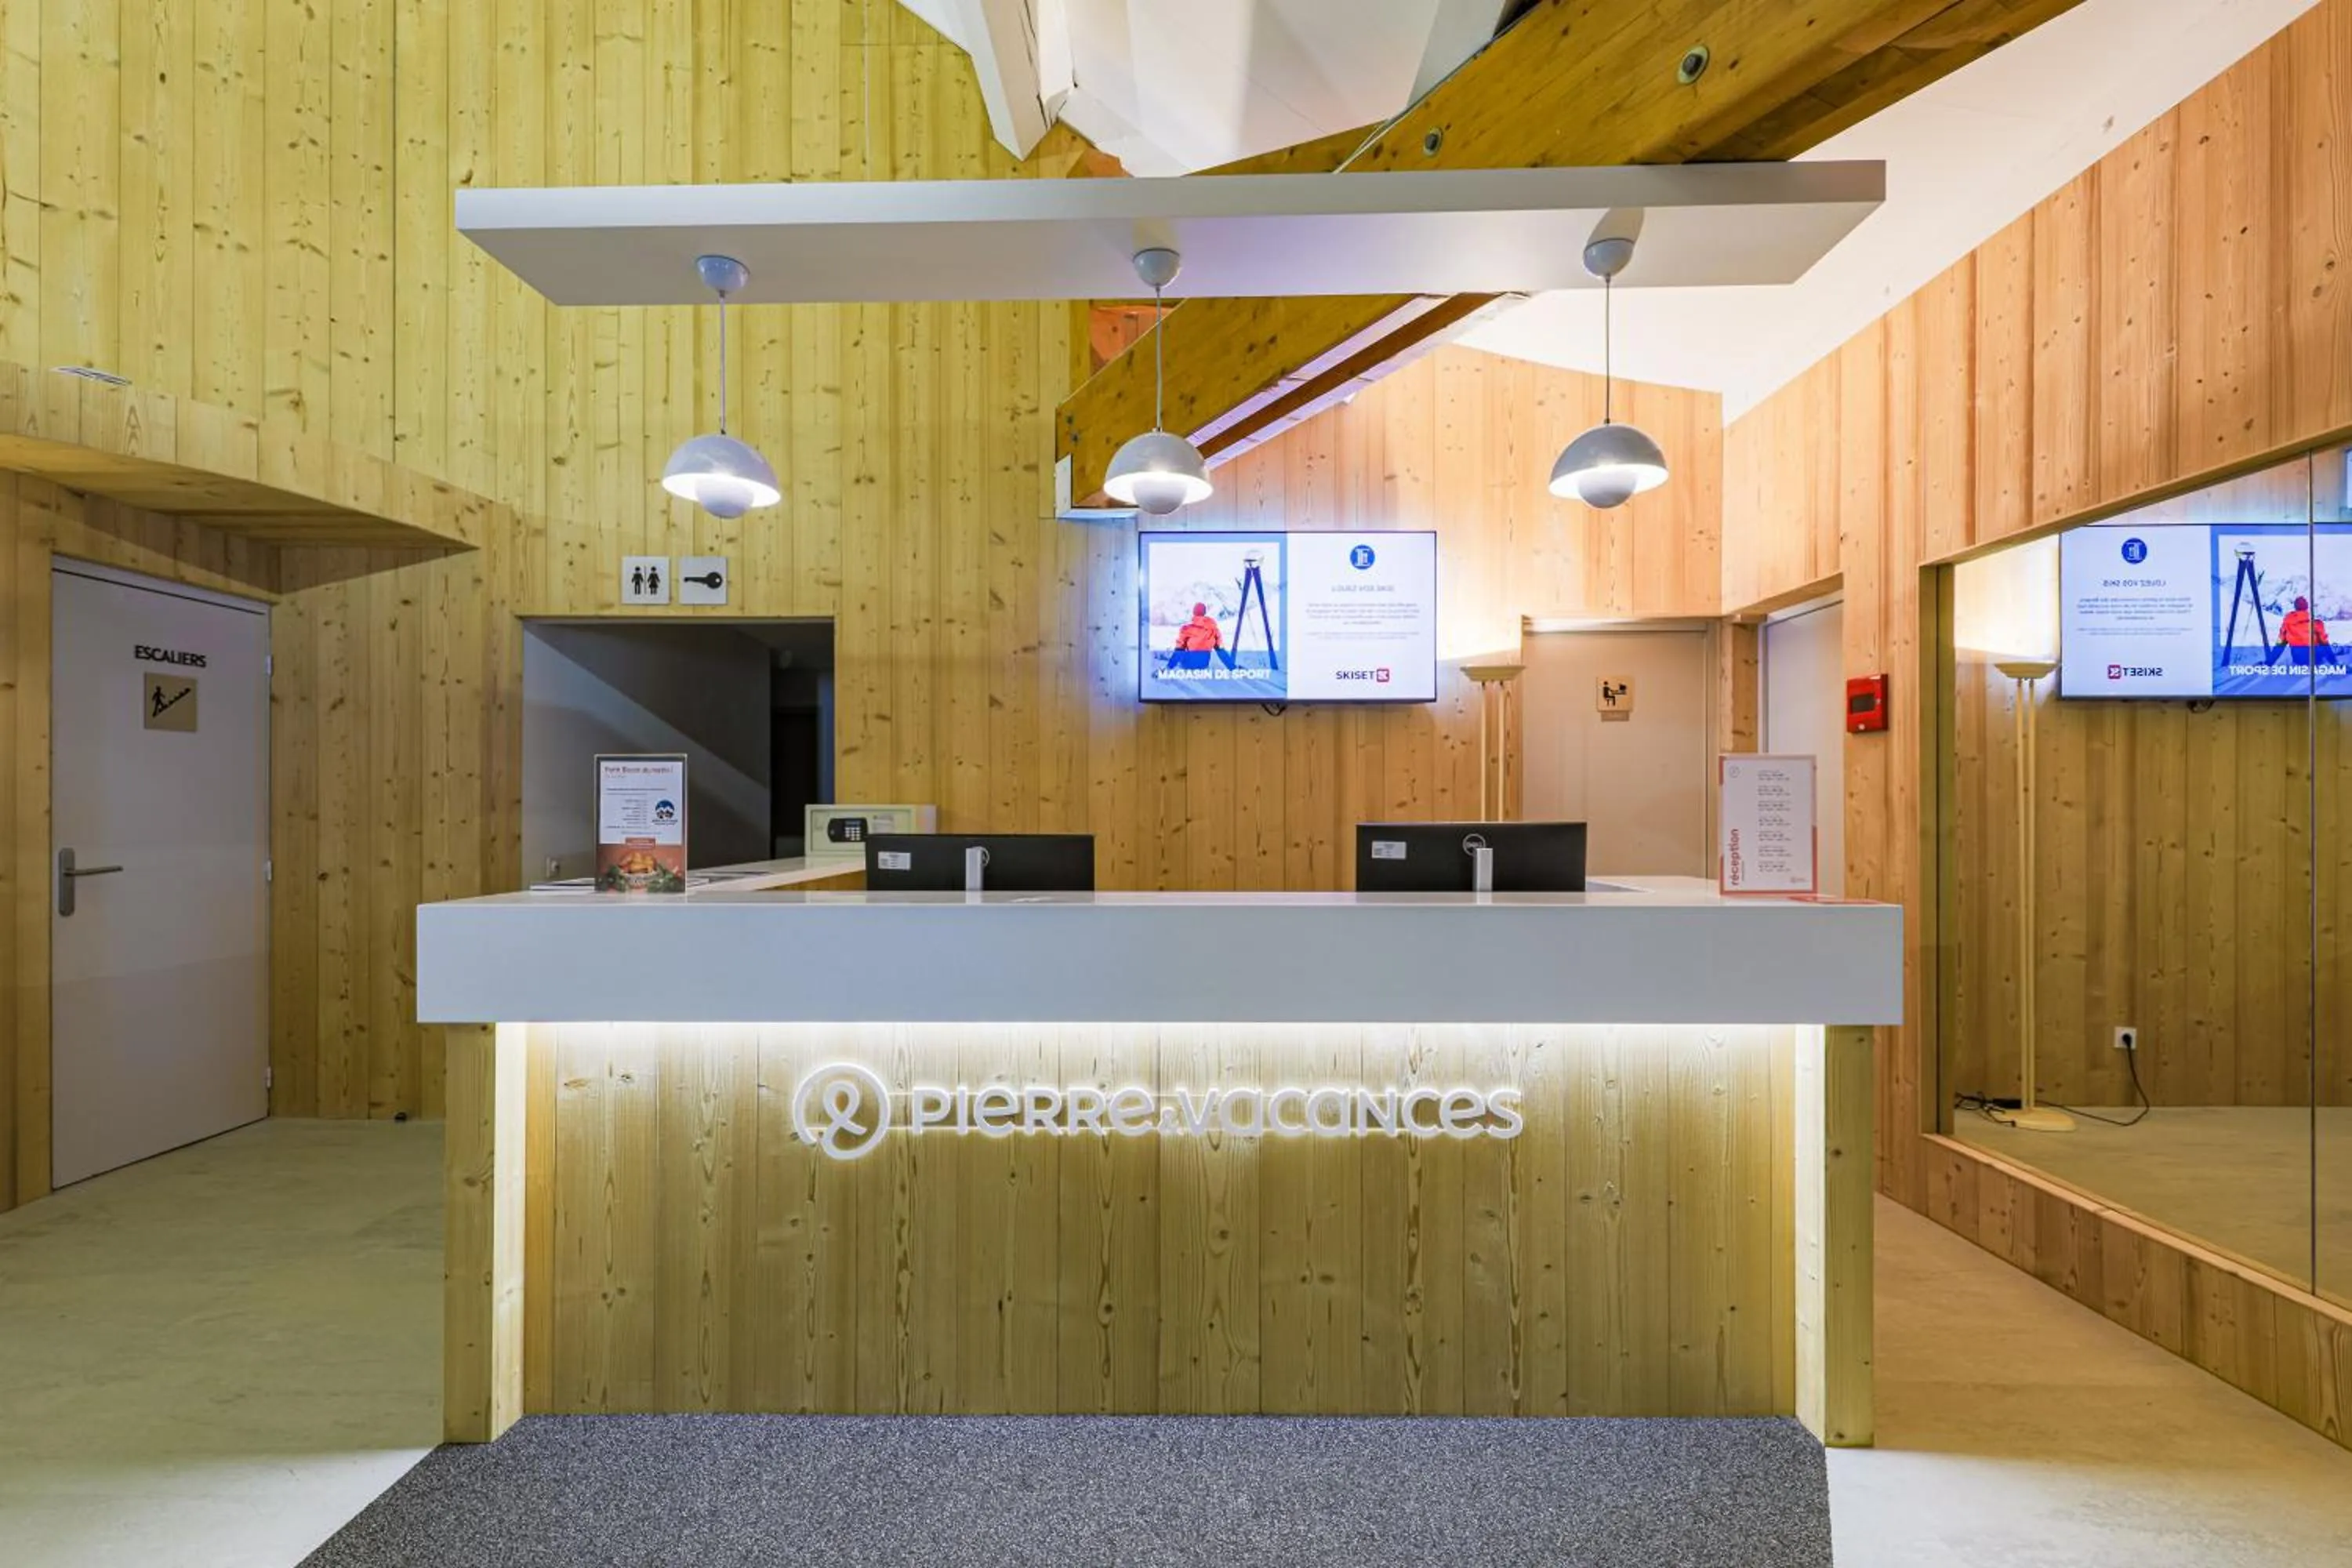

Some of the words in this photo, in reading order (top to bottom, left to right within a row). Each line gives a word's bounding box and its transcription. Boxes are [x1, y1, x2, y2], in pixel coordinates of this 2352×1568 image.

[134, 644, 206, 669] ESCALIERS
[1157, 668, 1213, 681] MAGASIN
[1214, 668, 1230, 681] DE
[1232, 668, 1272, 681] SPORT
[1335, 670, 1375, 680] SKISET
